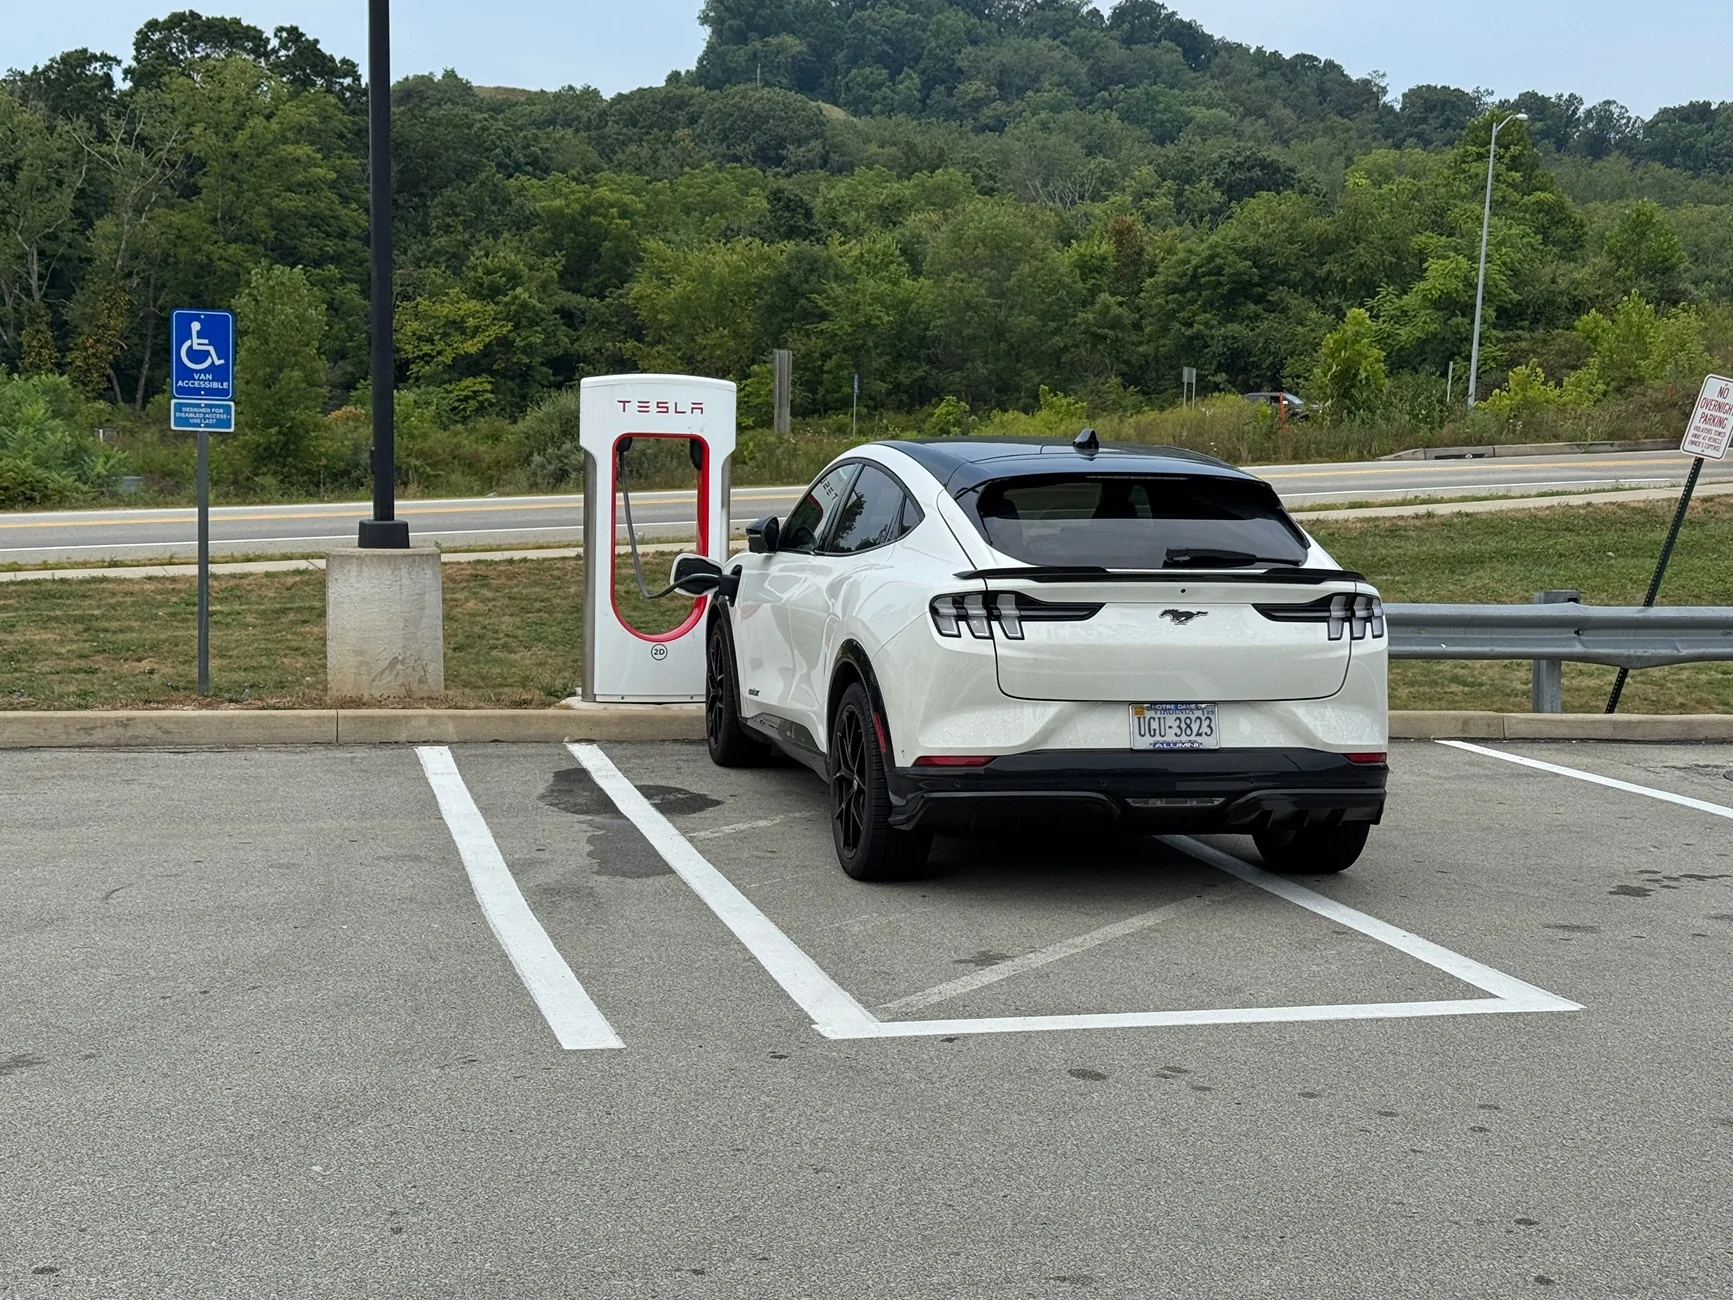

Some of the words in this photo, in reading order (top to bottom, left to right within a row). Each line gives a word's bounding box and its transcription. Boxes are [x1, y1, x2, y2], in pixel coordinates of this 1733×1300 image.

[177, 380, 228, 389] ACCESSIBLE
[1717, 386, 1729, 399] NO
[616, 400, 704, 414] TESLA
[1700, 397, 1733, 416] OVERNIGH
[1698, 411, 1728, 429] PARKING
[1136, 716, 1214, 738] UGU-3823
